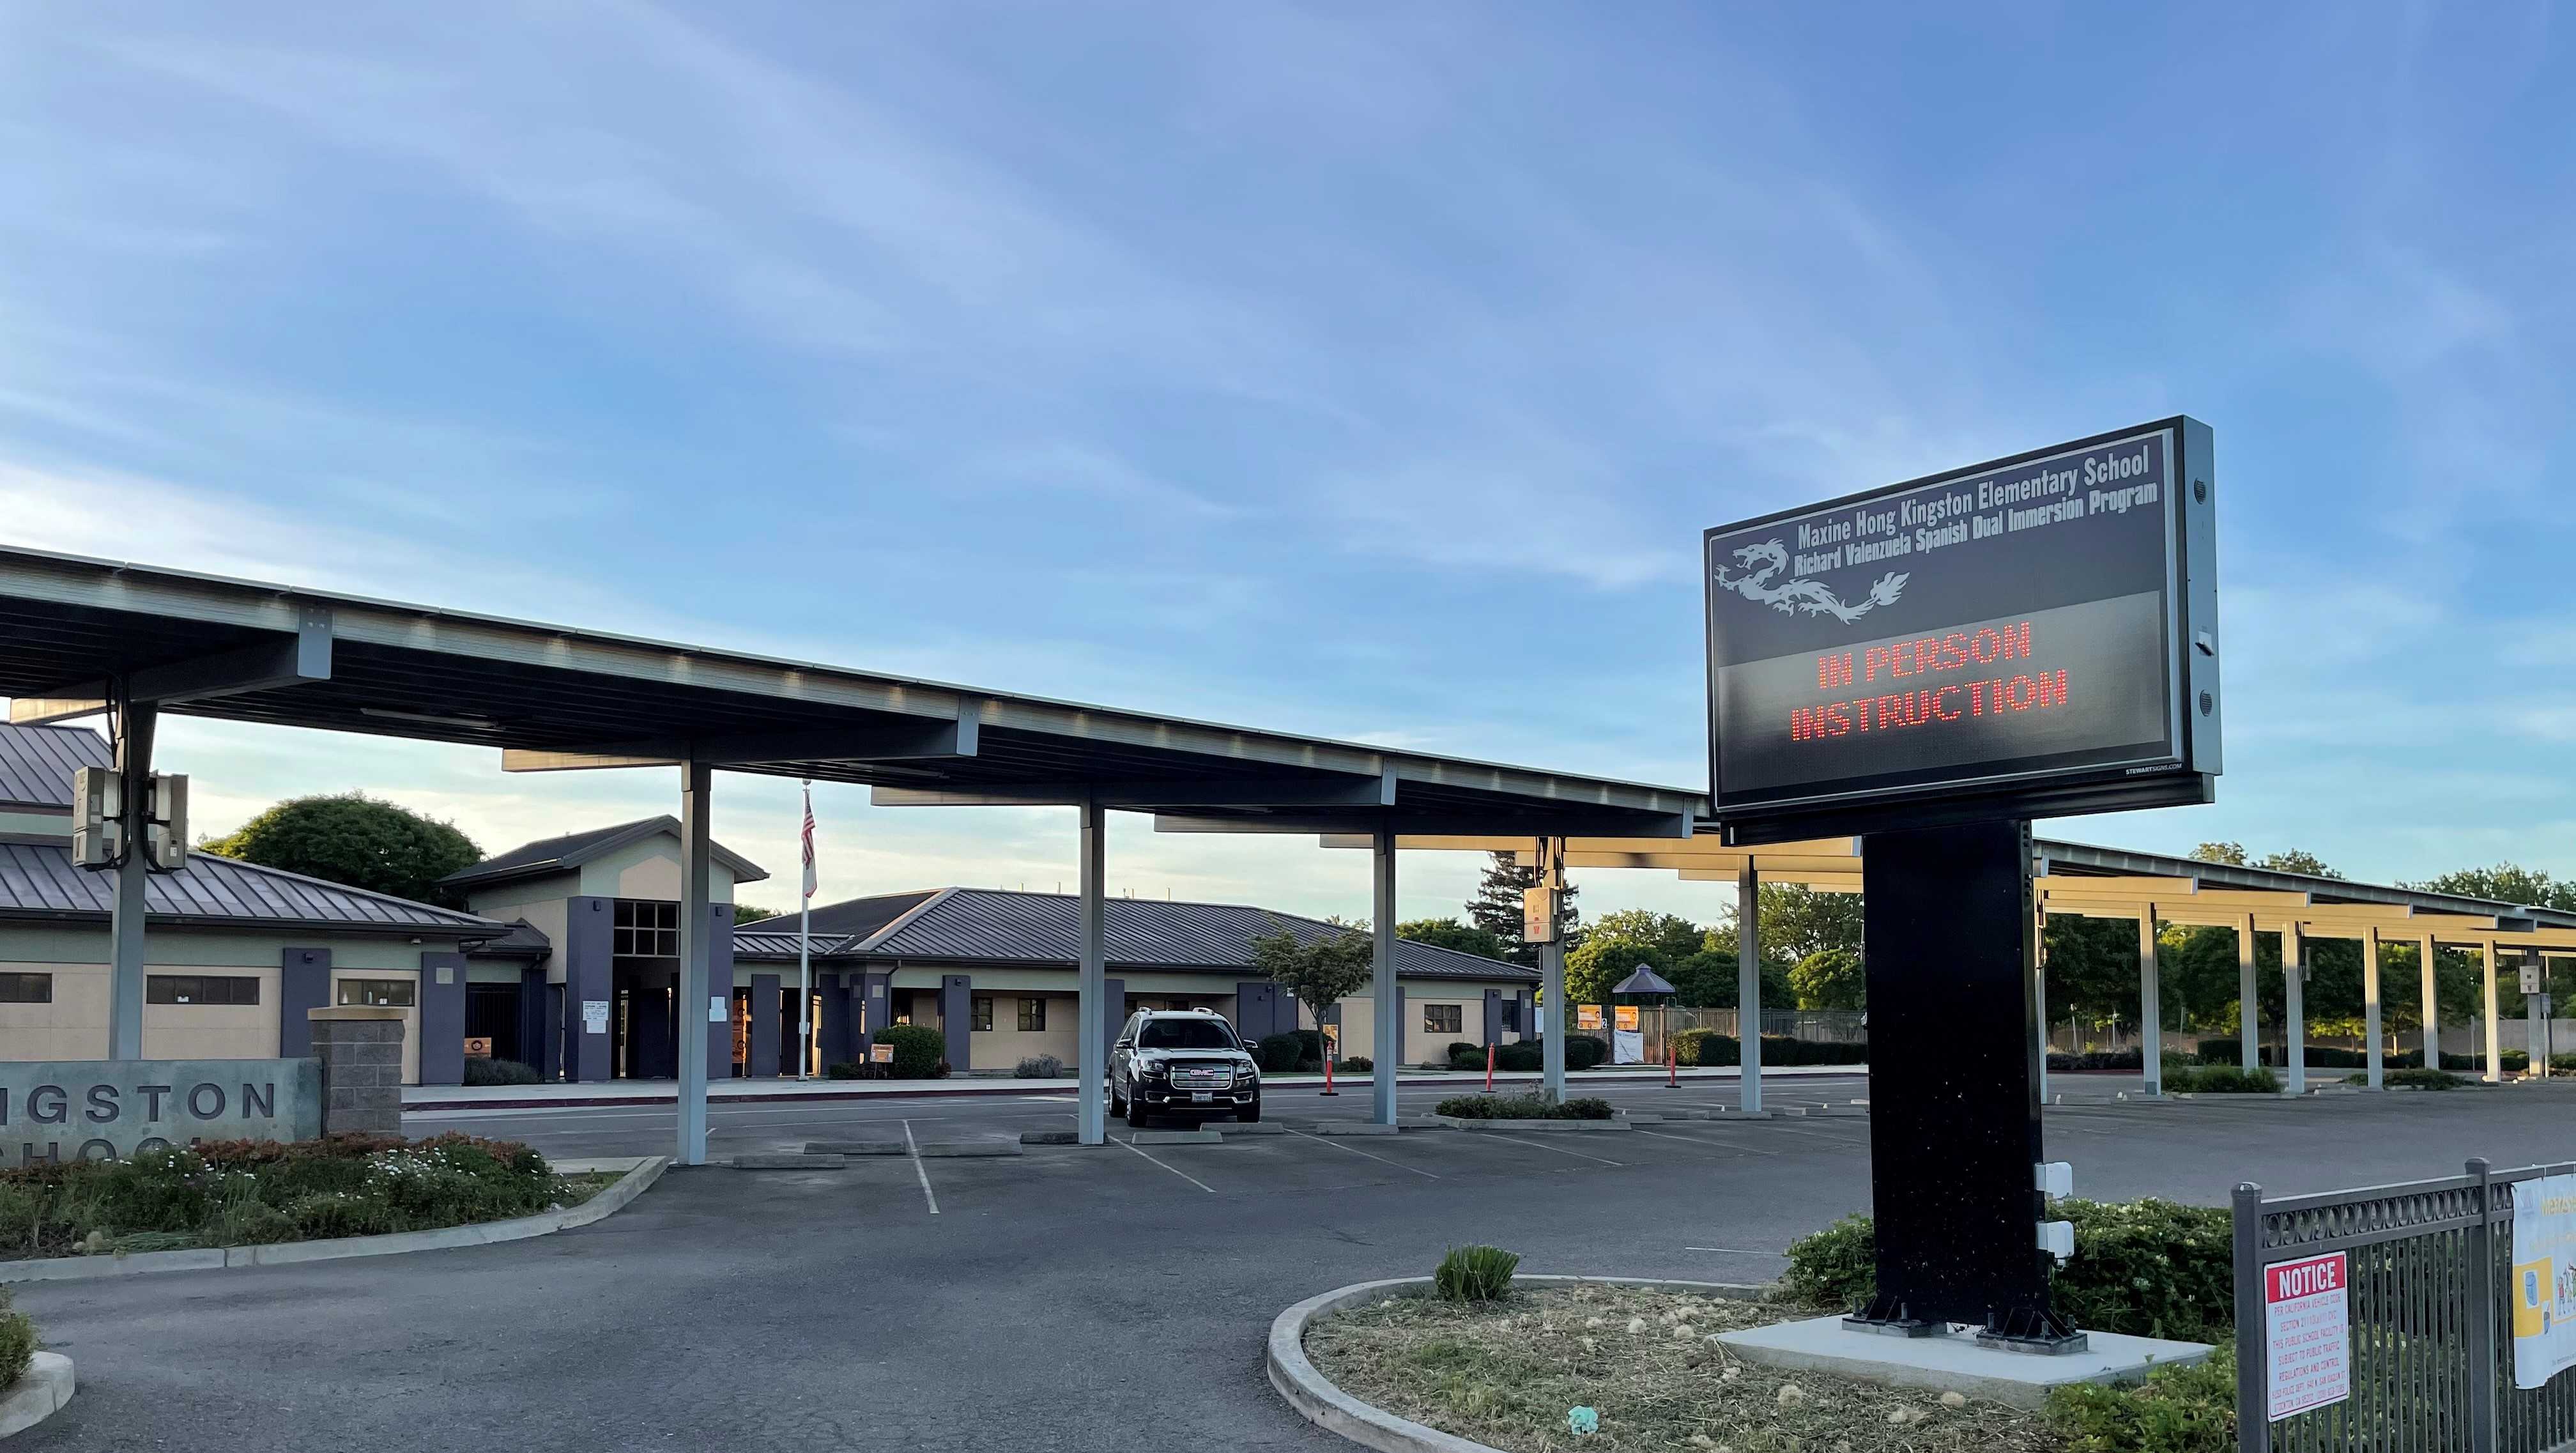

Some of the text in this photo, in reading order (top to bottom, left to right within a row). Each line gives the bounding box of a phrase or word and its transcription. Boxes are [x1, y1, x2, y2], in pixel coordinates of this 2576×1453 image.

[1798, 444, 2149, 550] Maxine Hong Kingston Elementary School
[1794, 482, 2158, 578] Richard Valenzuela Spanish Dual Immersion Program
[1818, 621, 2030, 689] IN PERSON
[1791, 669, 2067, 741] INSTRUCTION
[2126, 763, 2182, 775] STEWARTSIGNS.COM
[0, 1083, 274, 1126] GSTON
[2279, 1261, 2336, 1299] NOTICE
[2310, 1362, 2319, 1373] AND
